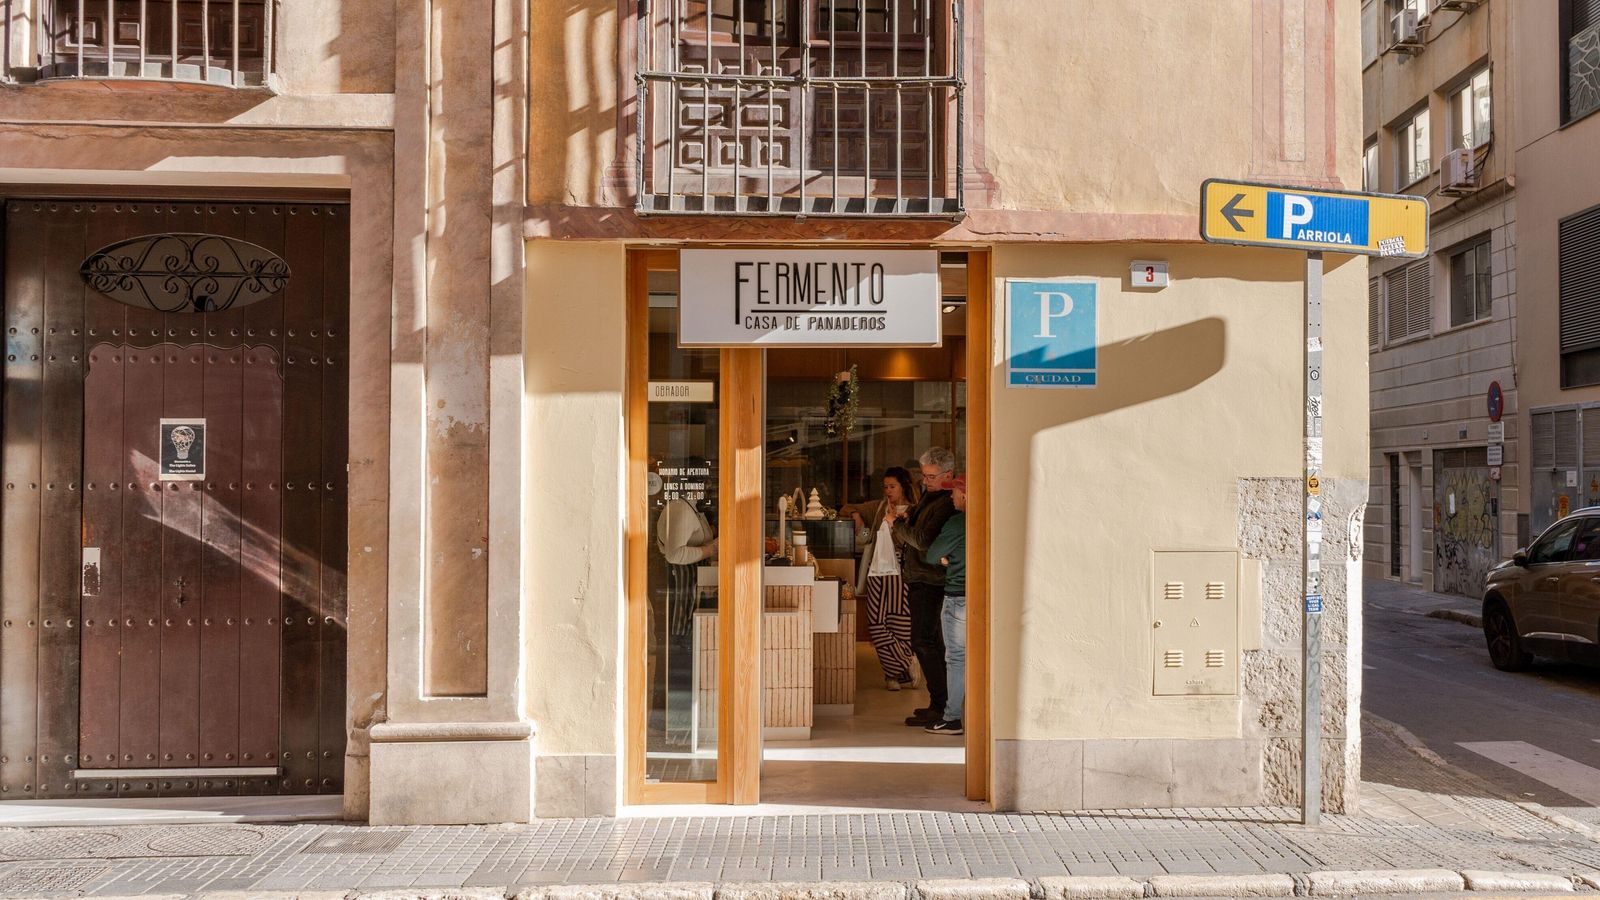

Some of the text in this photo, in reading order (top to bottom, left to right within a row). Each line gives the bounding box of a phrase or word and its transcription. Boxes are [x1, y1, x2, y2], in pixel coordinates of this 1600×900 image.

[1282, 194, 1352, 244] P ARRIOLA
[1145, 266, 1155, 283] 3
[734, 262, 885, 325] FERMENTO
[1032, 291, 1074, 338] P
[745, 316, 886, 331] CASA DE PANADEROS
[1025, 374, 1082, 384] CIUDAD
[655, 385, 690, 397] OBRADOR
